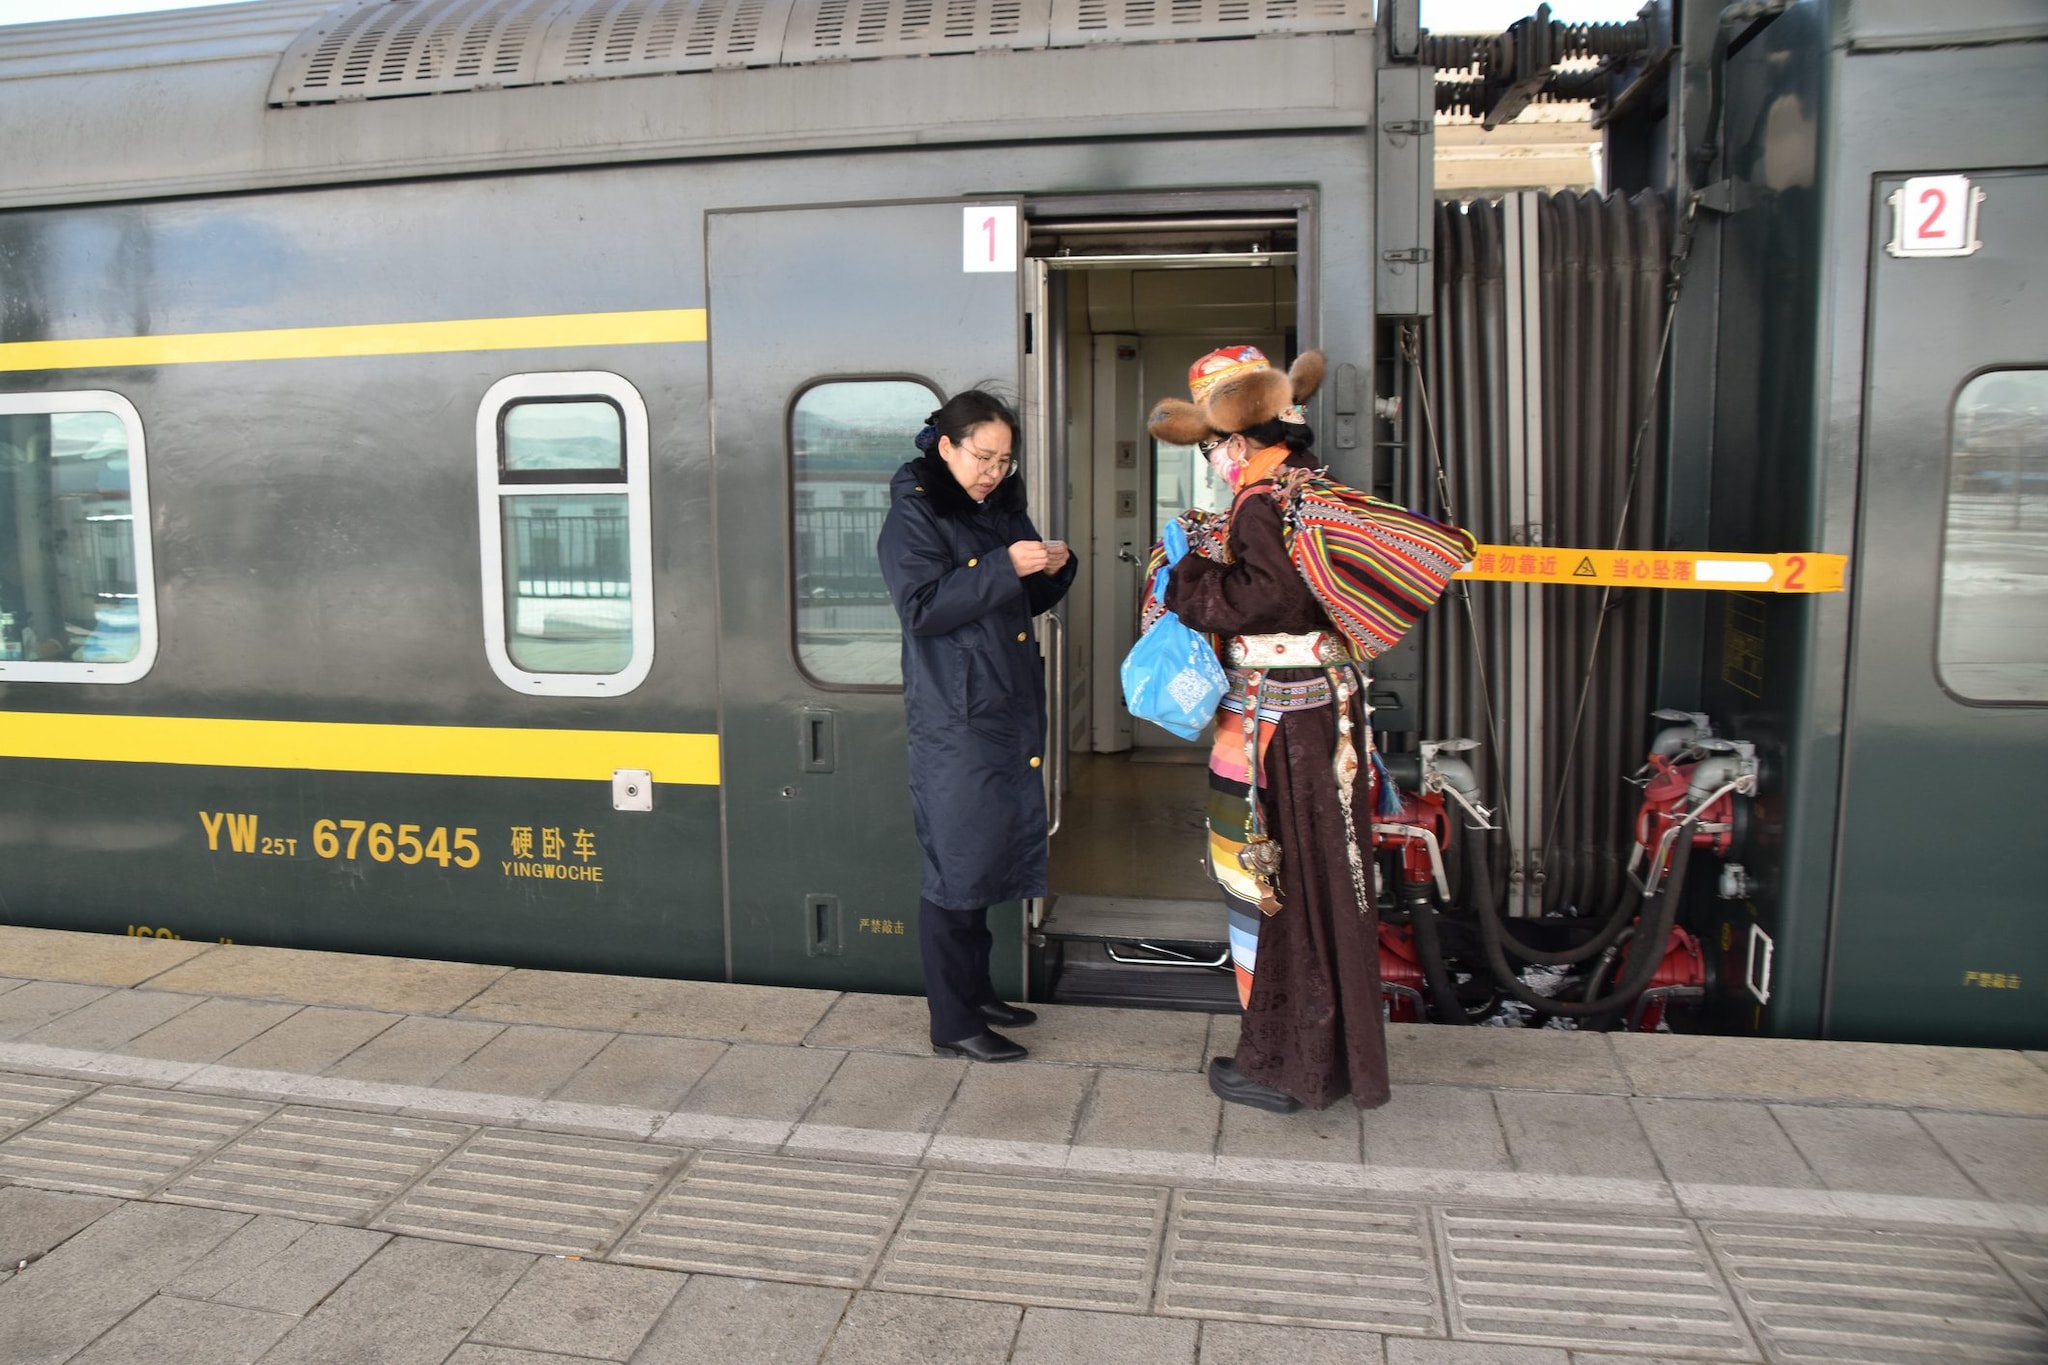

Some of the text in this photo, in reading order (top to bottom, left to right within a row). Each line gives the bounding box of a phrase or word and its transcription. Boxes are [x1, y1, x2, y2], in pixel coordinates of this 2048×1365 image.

[1918, 188, 1947, 239] 2
[982, 216, 996, 262] 1
[1477, 552, 1692, 581] 请勿靠近 当心坠落
[1784, 556, 1807, 590] 2
[312, 818, 481, 869] 676545
[510, 826, 597, 862] 硬卧车
[501, 861, 604, 882] YINGWOCHE
[859, 918, 905, 935] 严禁敲击
